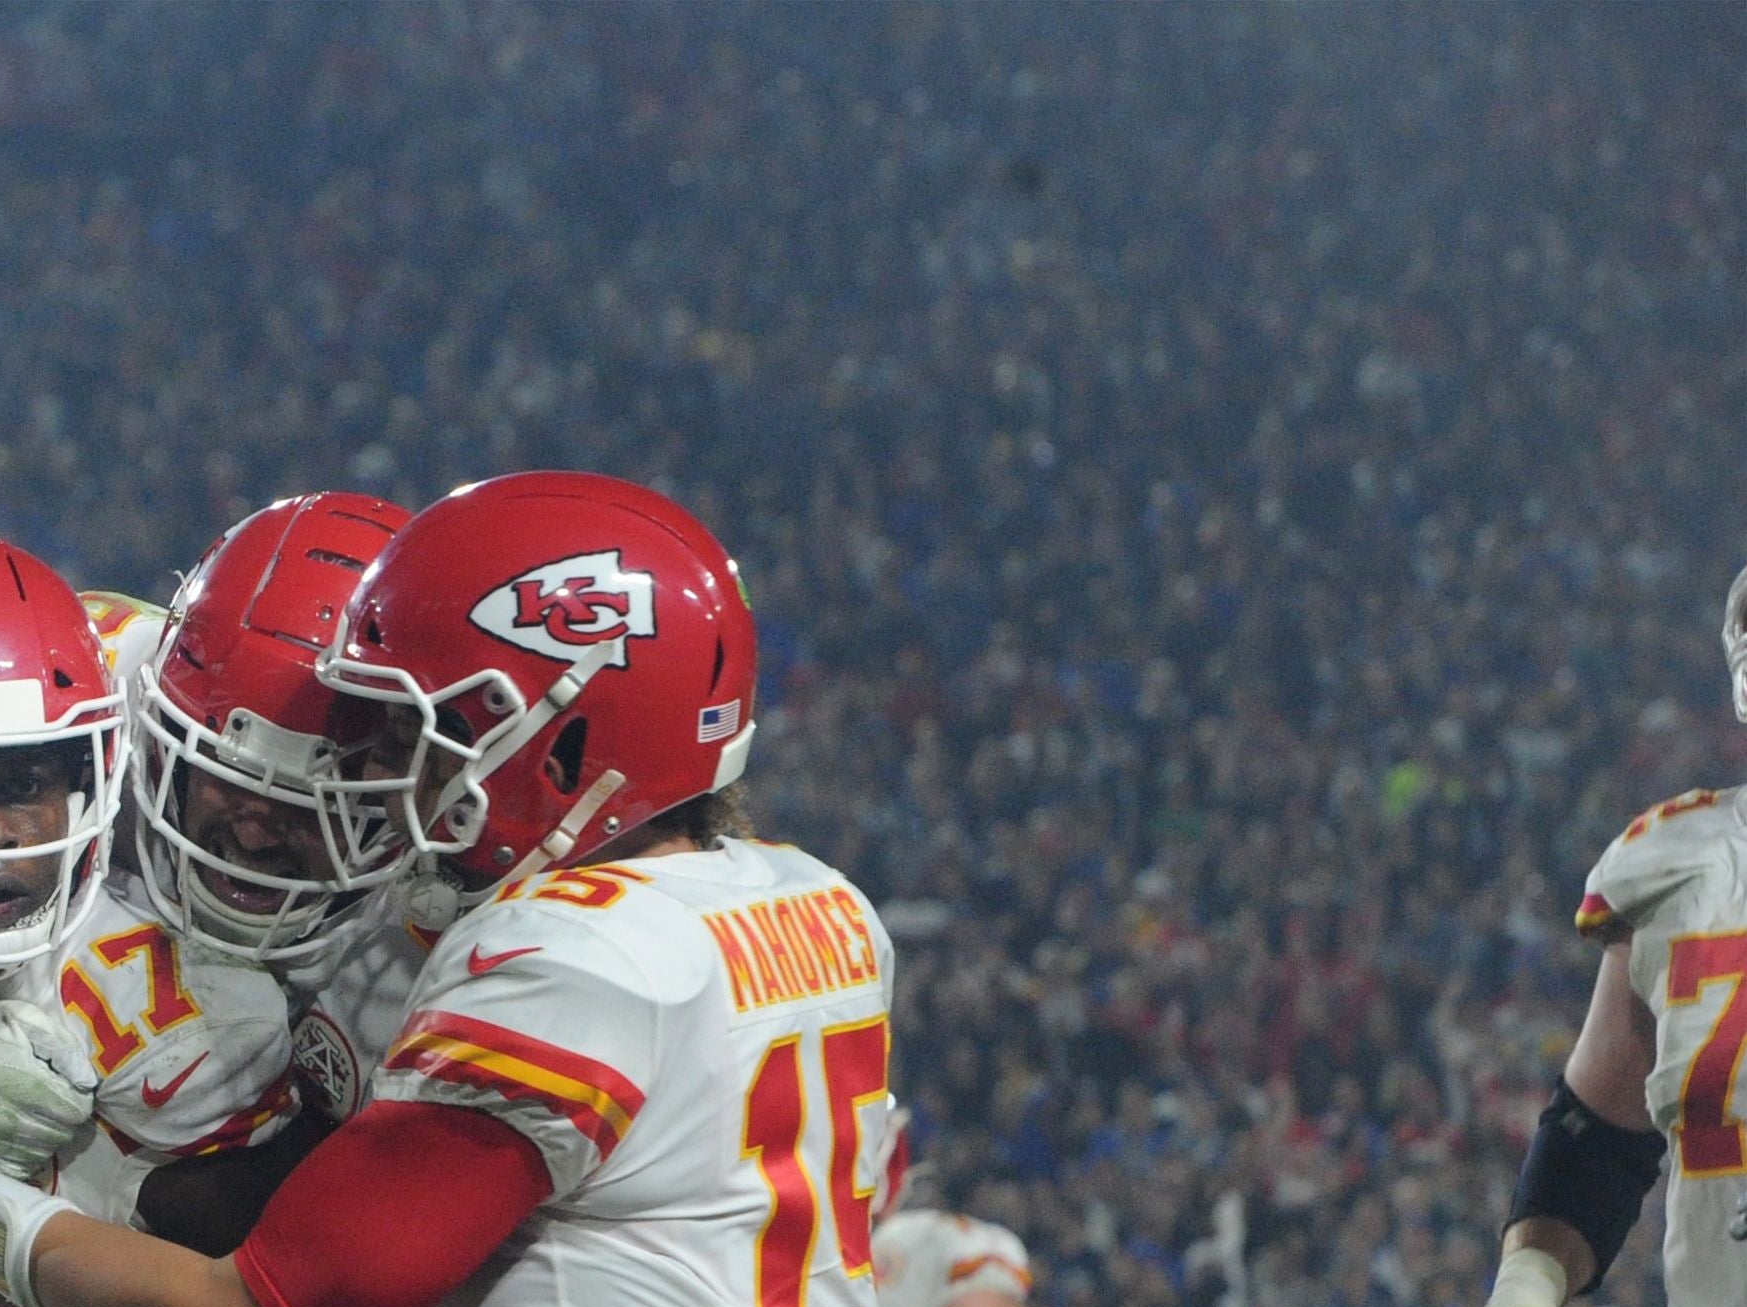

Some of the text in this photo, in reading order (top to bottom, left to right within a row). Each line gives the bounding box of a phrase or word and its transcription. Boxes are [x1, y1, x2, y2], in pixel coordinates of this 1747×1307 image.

[511, 576, 629, 645] KC
[61, 921, 203, 1079] 17
[702, 886, 881, 1013] MAHOMES
